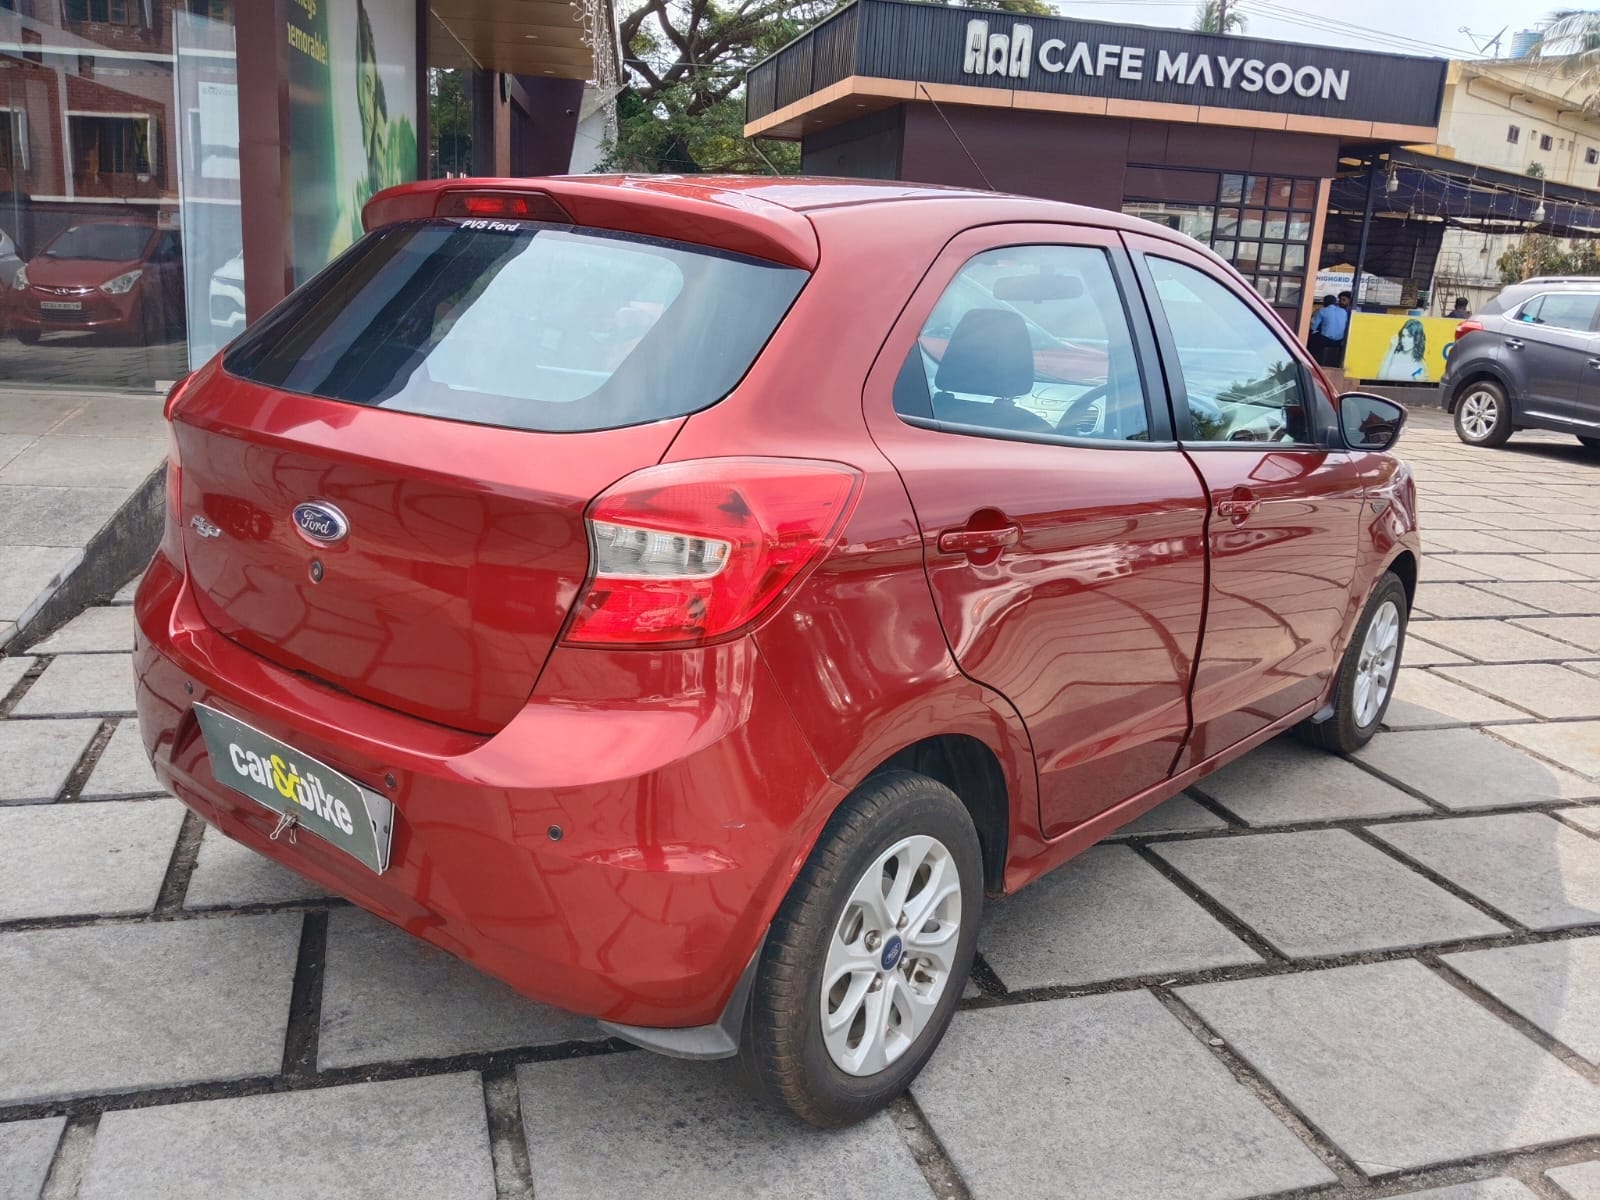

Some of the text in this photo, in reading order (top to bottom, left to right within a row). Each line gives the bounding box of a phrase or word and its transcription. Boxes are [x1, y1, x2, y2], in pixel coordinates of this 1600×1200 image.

[1038, 38, 1350, 101] CAFE MAYSOON
[460, 220, 520, 232] PVS Ford
[300, 509, 330, 535] Ford
